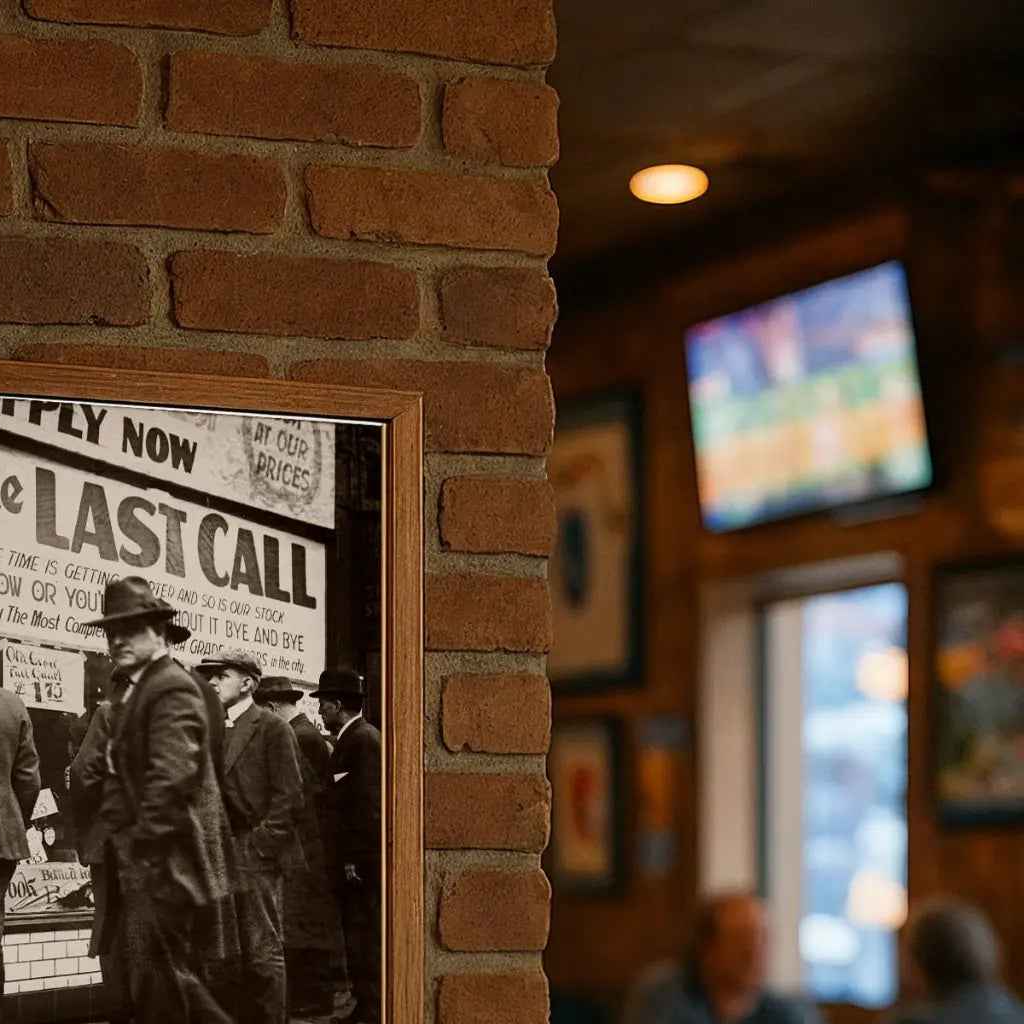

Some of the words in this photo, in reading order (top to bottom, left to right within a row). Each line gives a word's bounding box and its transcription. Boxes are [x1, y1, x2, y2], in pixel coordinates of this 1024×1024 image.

[122, 416, 197, 473] NOW
[254, 422, 272, 446] AT
[277, 430, 309, 460] OUR
[256, 452, 310, 492] PRICES
[35, 467, 187, 578] LAST
[197, 513, 317, 610] CALL
[8, 551, 40, 571] TIME
[45, 560, 58, 575] IS
[177, 588, 197, 605] AND
[201, 594, 215, 608] SO
[217, 600, 226, 611] IS
[230, 601, 251, 616] OUR
[255, 607, 286, 625] STOCK
[32, 580, 57, 604] OR
[209, 616, 219, 635] IT
[225, 620, 249, 642] BYE
[254, 627, 278, 647] AND
[282, 632, 305, 653] BYE
[8, 605, 28, 625] The
[30, 610, 61, 631] Most
[278, 656, 290, 670] the
